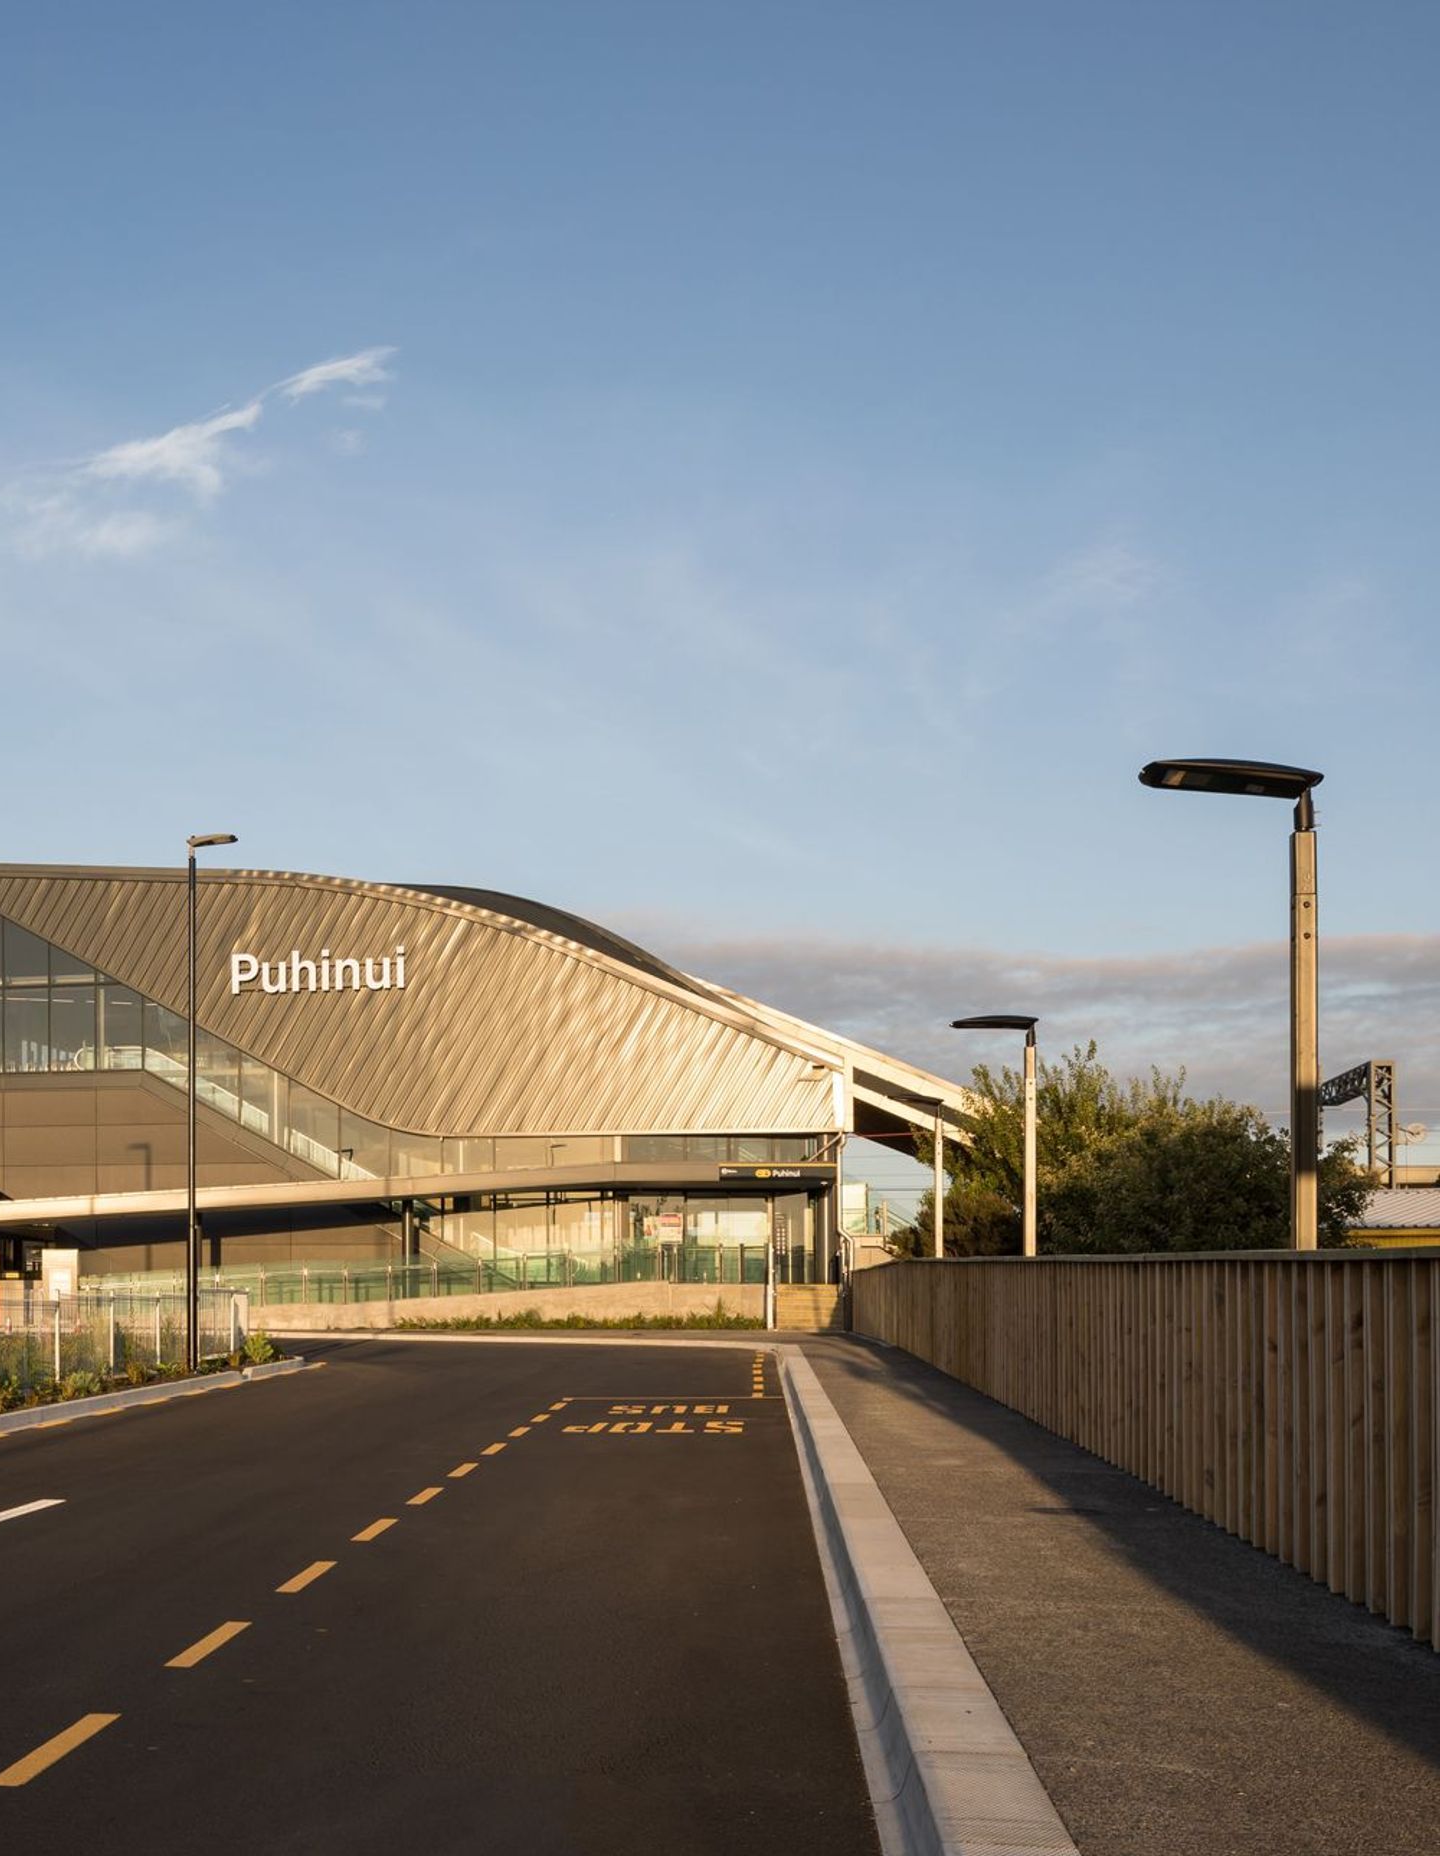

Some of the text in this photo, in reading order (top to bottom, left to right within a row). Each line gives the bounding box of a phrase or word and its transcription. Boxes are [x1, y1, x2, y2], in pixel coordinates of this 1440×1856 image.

[231, 946, 405, 994] Puhinui
[772, 1169, 800, 1178] Puhinui
[608, 1405, 729, 1414] BUS
[562, 1421, 745, 1433] STOP
